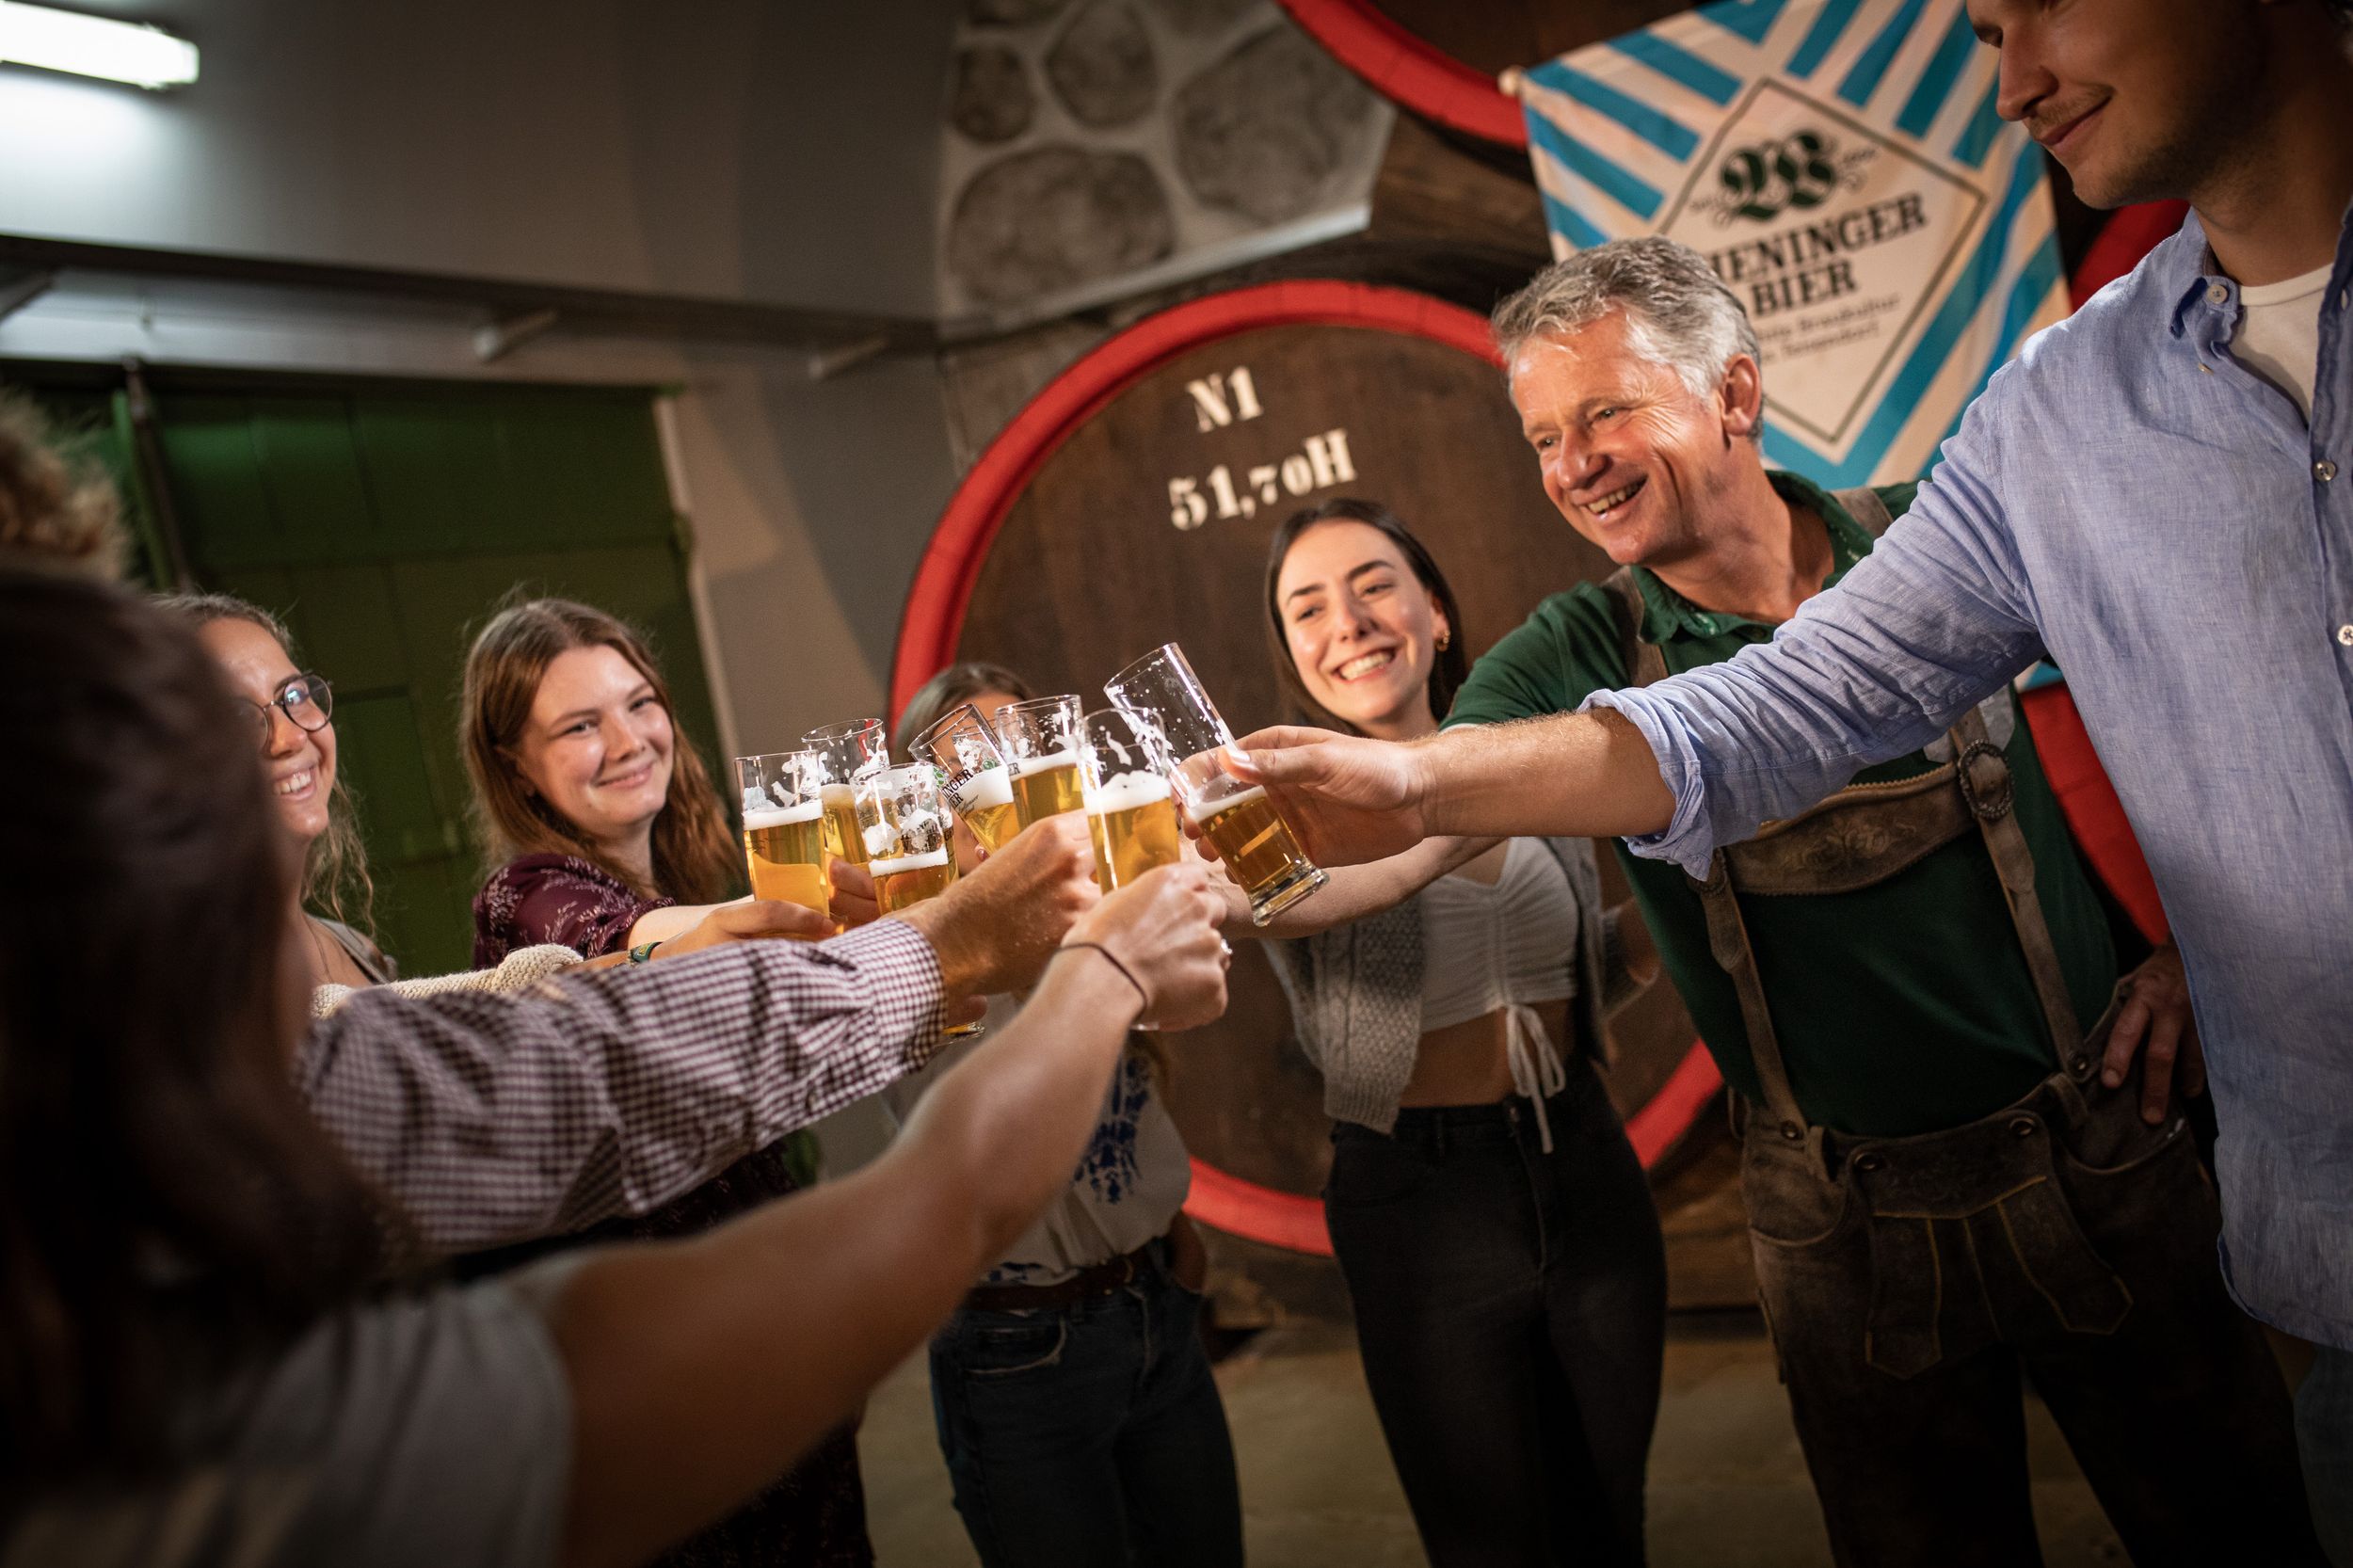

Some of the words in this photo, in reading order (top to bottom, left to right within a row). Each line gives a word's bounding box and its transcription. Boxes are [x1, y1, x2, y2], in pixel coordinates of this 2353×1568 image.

[1708, 190, 1927, 283] IENINGER
[1752, 260, 1857, 316] BIER
[942, 768, 974, 800] INGER
